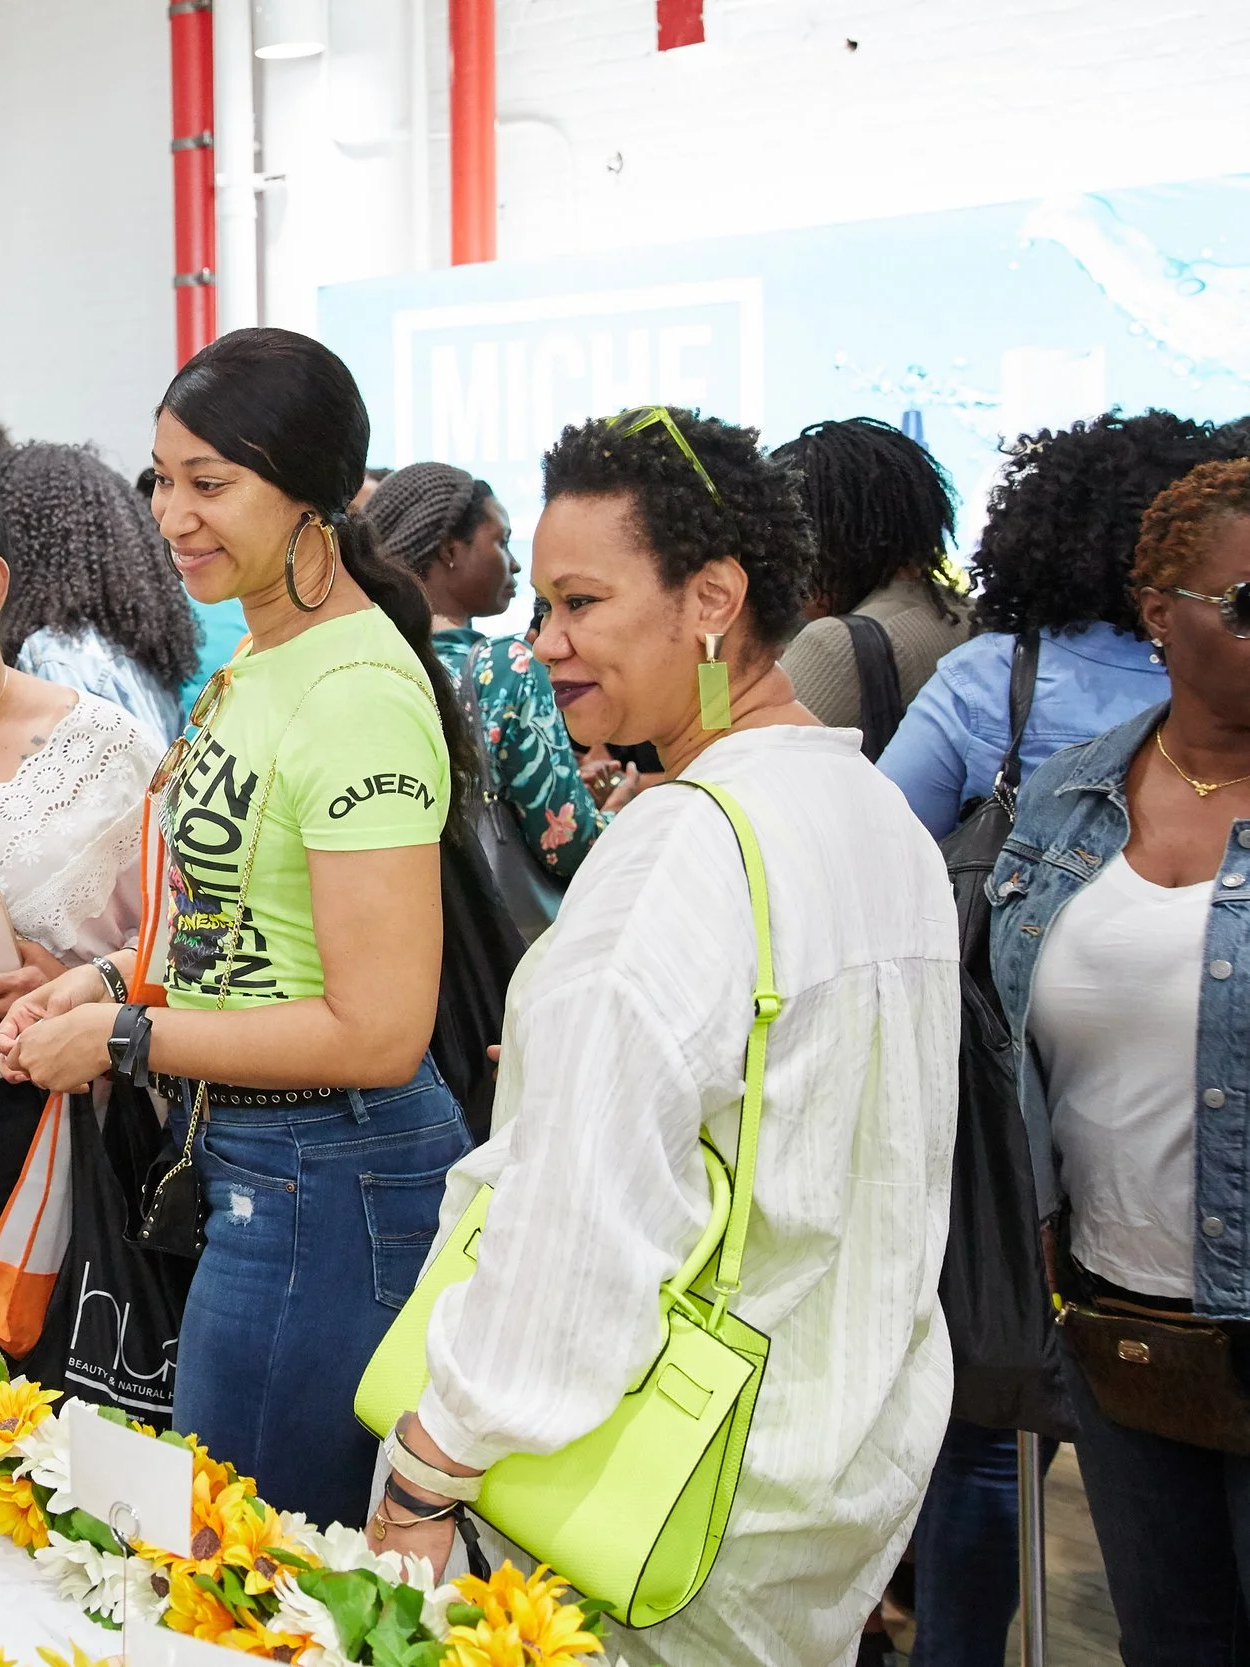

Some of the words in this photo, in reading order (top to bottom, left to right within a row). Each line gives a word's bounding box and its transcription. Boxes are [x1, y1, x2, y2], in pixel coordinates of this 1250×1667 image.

[328, 773, 436, 819] QUEEN
[68, 1357, 109, 1379] BEAUTY
[108, 1376, 116, 1387] &
[118, 1380, 166, 1399] NATURAL
